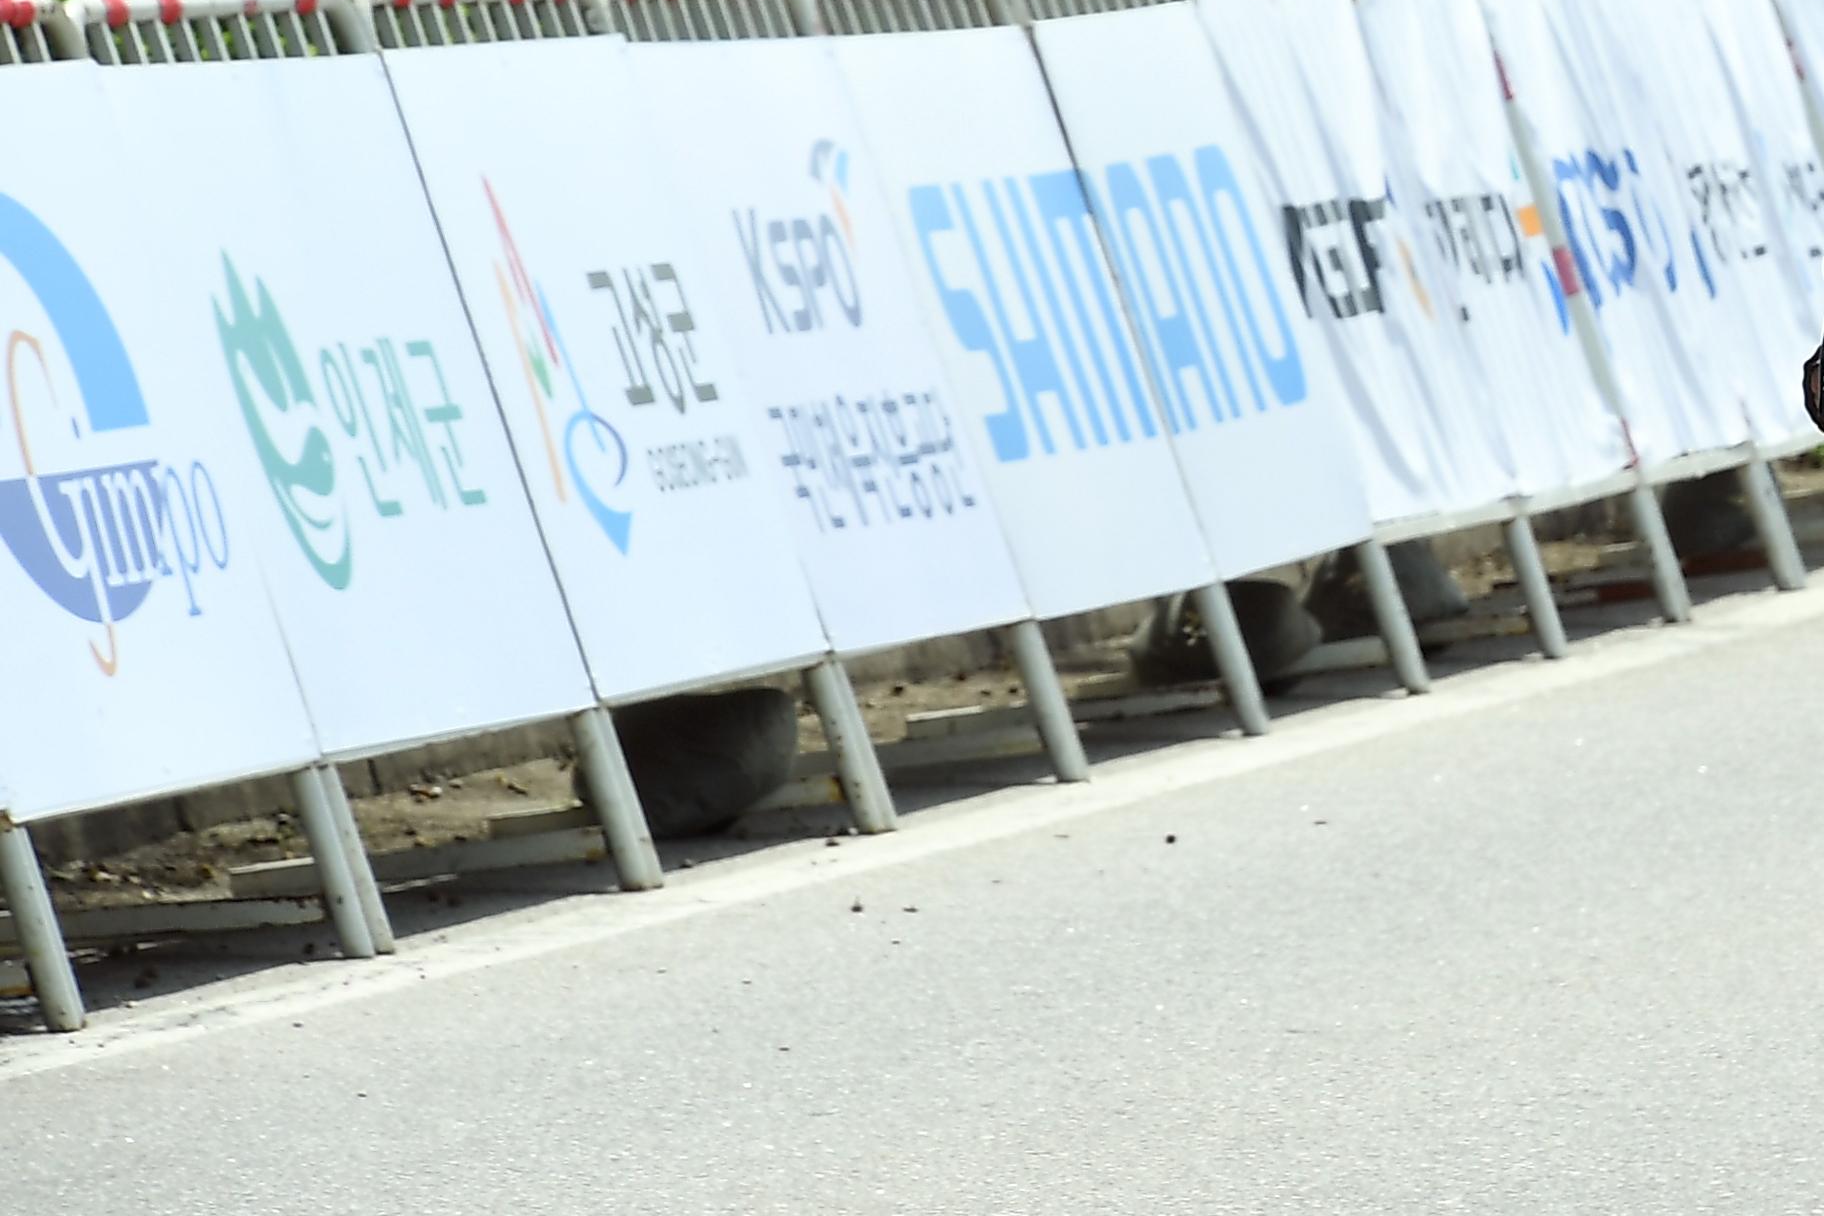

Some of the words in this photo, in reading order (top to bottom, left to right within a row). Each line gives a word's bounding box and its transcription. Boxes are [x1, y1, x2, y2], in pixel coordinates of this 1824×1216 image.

[586, 262, 719, 416] 고성군
[732, 206, 863, 335] KSPO
[908, 144, 1308, 463] SHIMANO
[318, 336, 488, 518] 인제군
